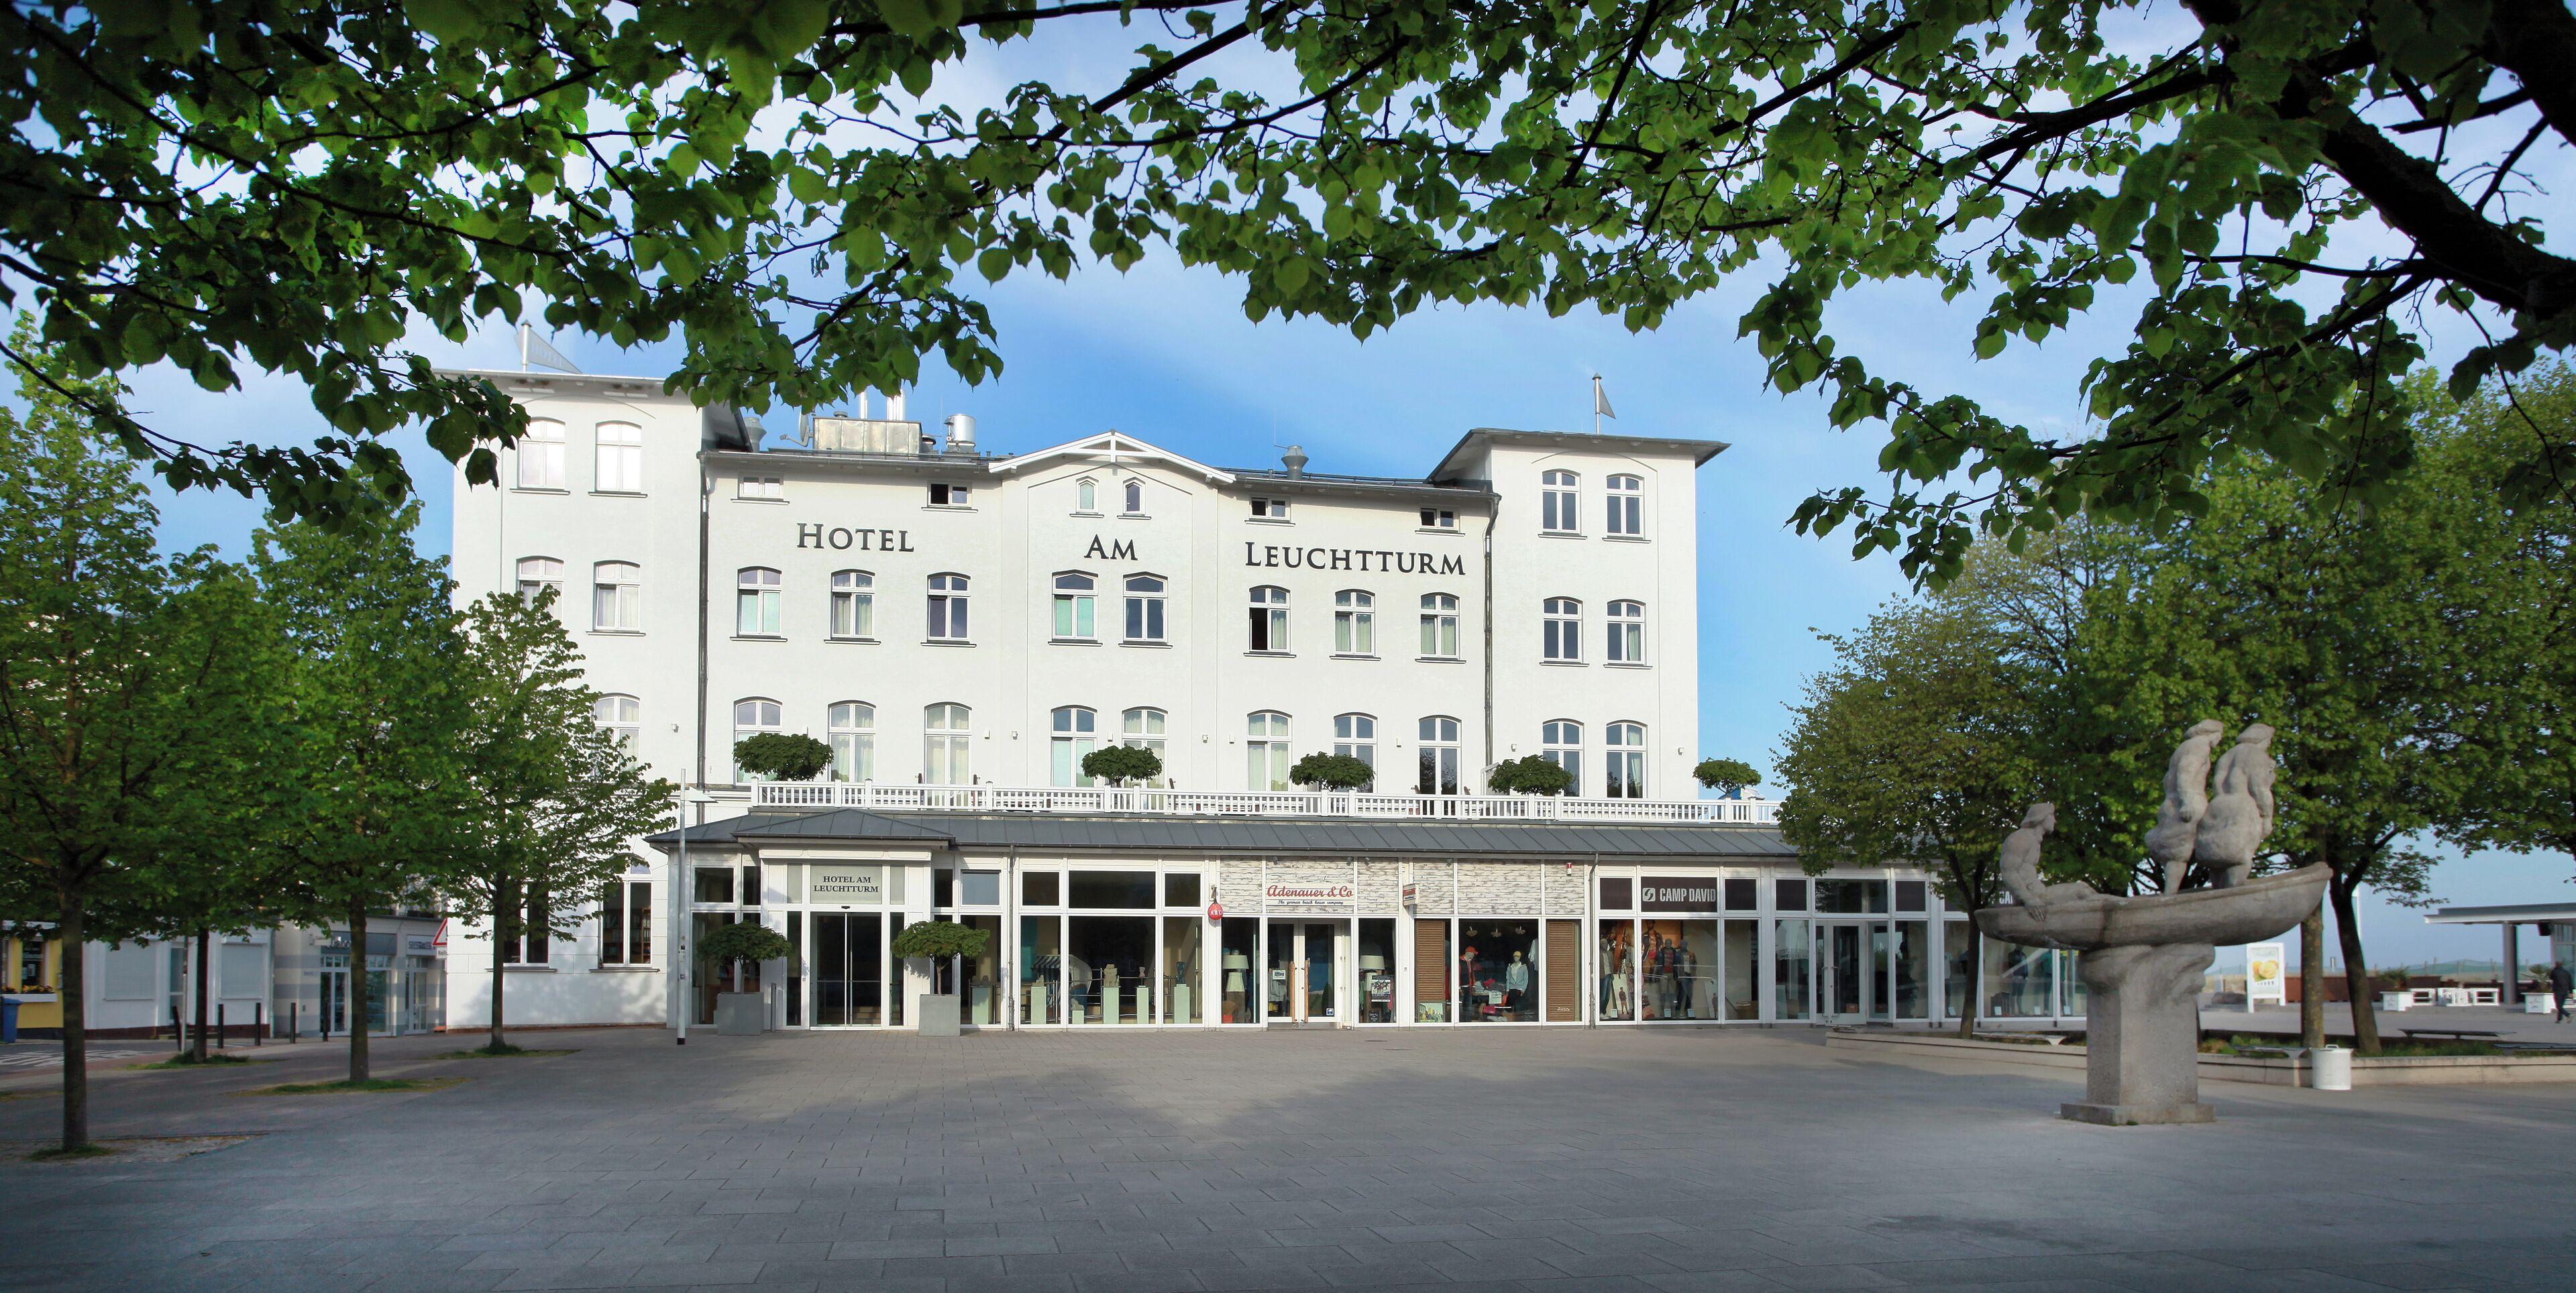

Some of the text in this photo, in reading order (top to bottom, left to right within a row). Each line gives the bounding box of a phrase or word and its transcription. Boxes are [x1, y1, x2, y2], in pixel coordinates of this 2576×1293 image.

[796, 522, 1466, 575] HOTEL AM LEUCHTTURM
[1267, 885, 1354, 897] Adenauer & Co
[1660, 888, 1716, 902] CAMP DAVID
